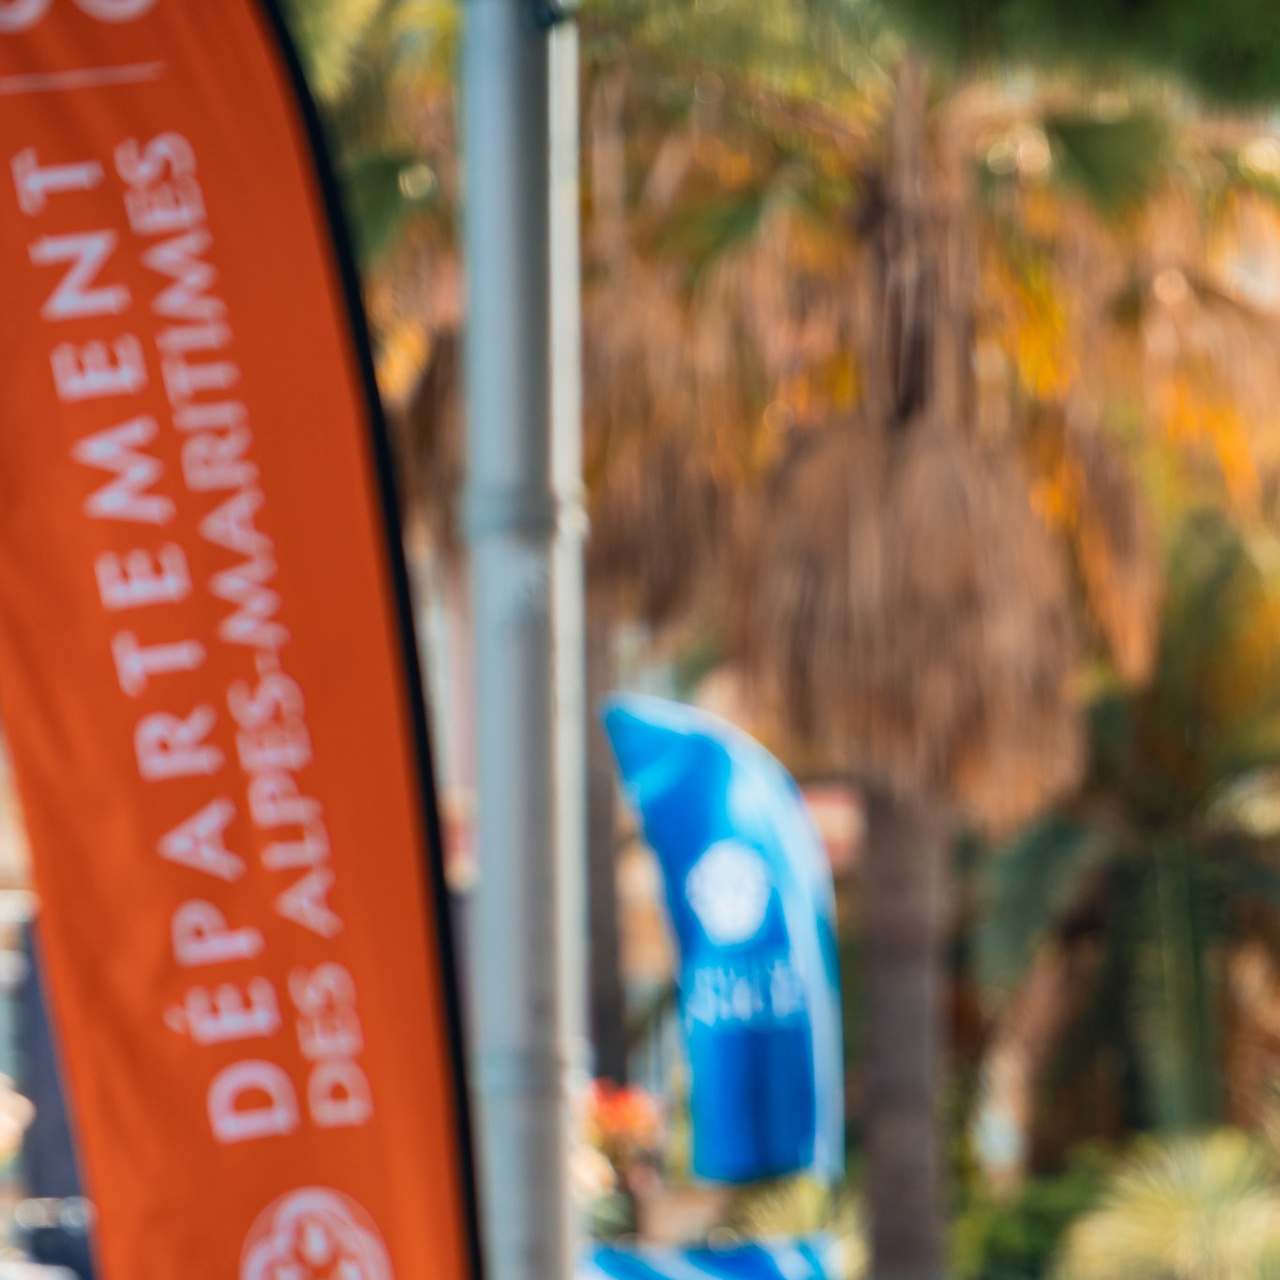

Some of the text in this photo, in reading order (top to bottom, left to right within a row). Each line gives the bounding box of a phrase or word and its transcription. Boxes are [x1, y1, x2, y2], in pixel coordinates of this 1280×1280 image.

[10, 147, 299, 1144] DÉPARTEMENT
[113, 131, 373, 1127] DES ALPES-MARITIMES
